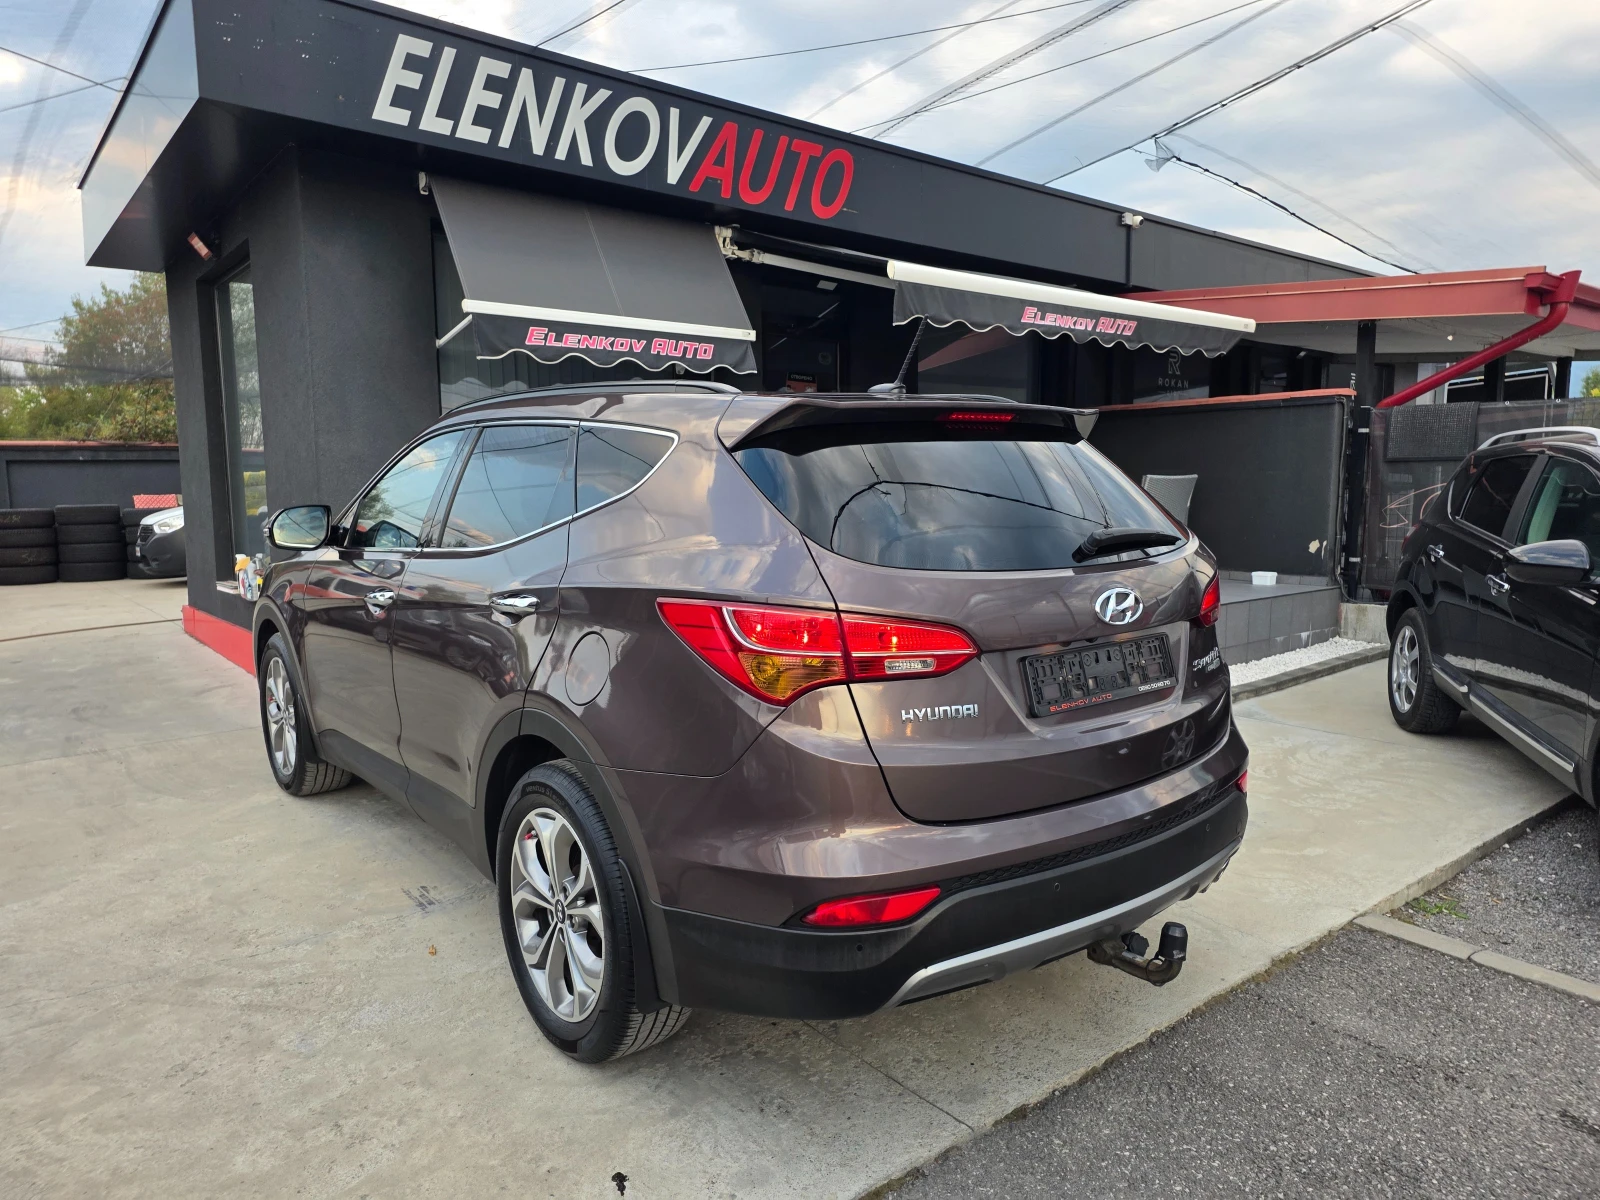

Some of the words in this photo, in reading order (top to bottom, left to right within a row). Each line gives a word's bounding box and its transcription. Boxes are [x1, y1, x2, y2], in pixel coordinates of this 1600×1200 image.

[1095, 316, 1137, 336] AUTO
[651, 337, 714, 360] AUTO
[1158, 377, 1189, 389] ROKAN
[1091, 693, 1112, 703] AUTO
[901, 703, 979, 723] HYUNDAI
